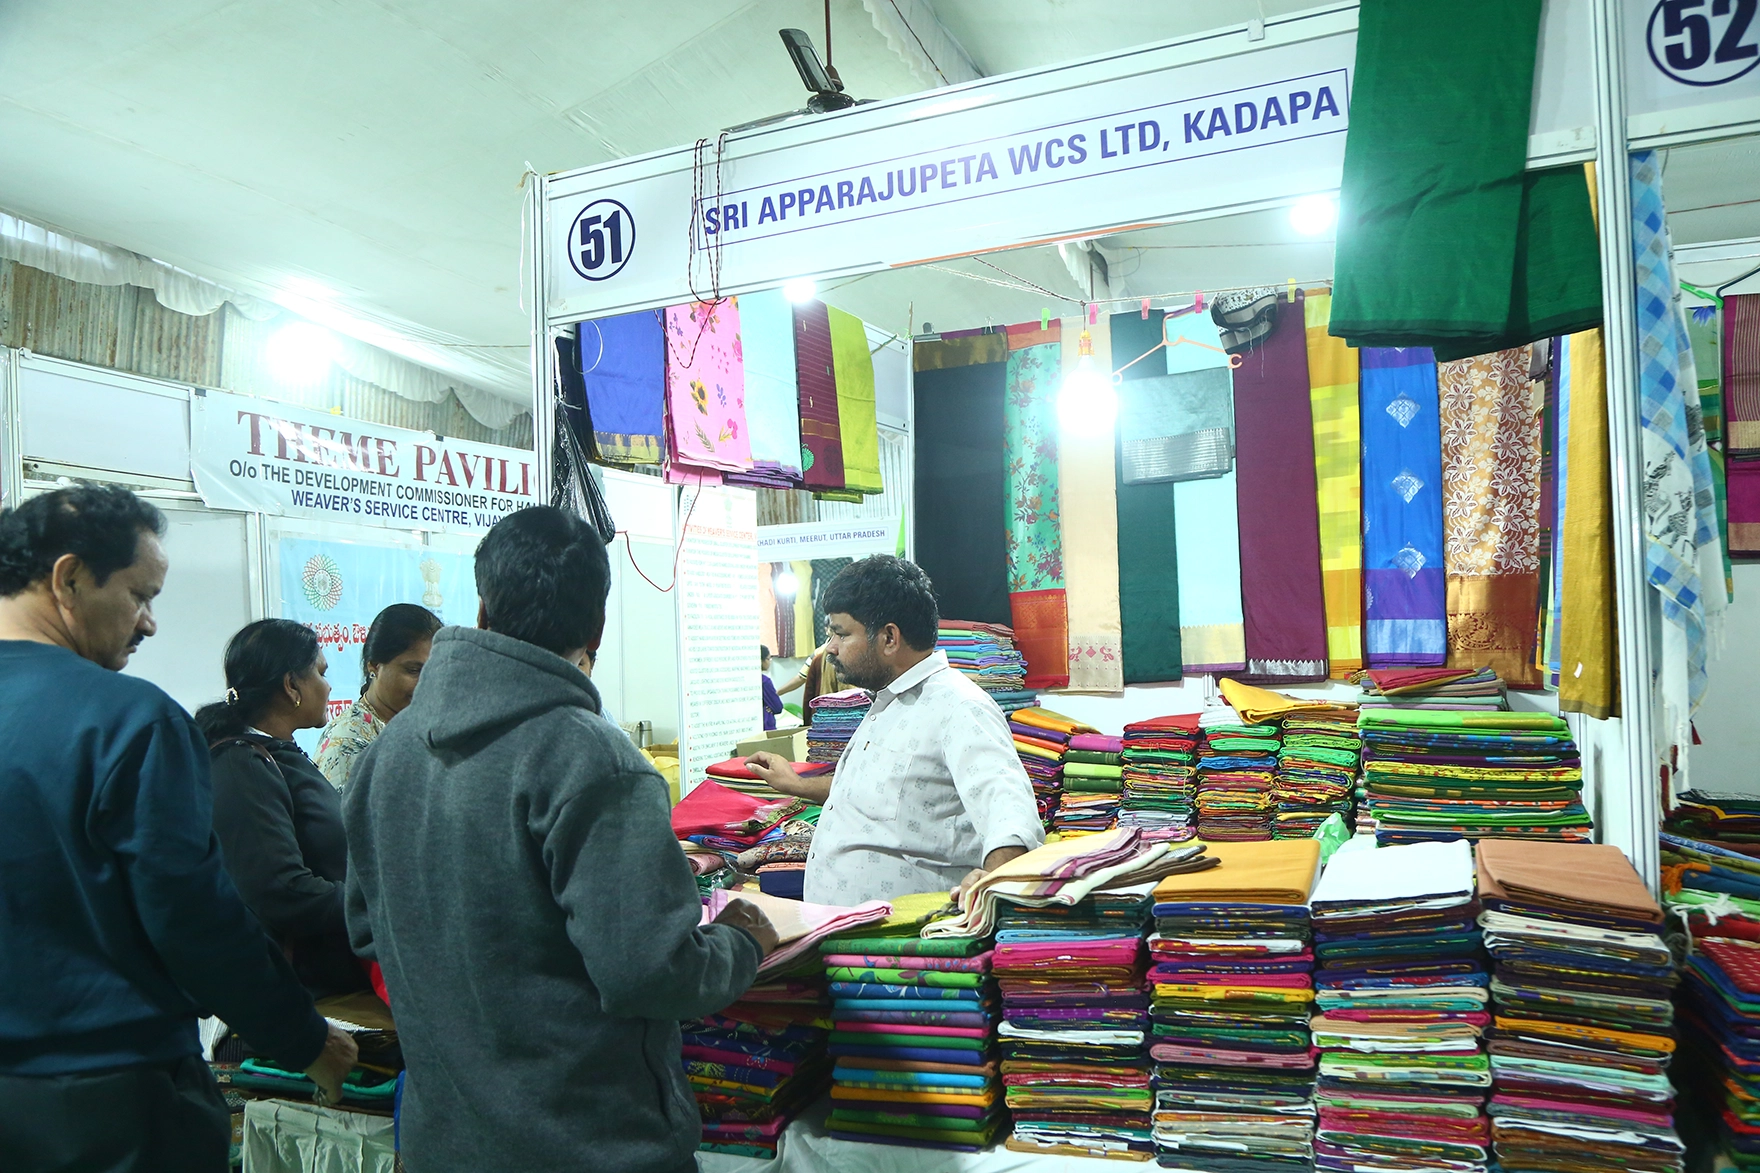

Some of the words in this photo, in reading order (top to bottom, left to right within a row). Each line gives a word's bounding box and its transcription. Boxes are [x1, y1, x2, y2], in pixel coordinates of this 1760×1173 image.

[1663, 0, 1758, 70] 52
[705, 201, 748, 236] SRI
[758, 152, 998, 225] APPARAJUPETA
[1008, 133, 1087, 175] WCS
[1100, 120, 1170, 159] LTD,
[1183, 86, 1340, 144] KADAPA
[580, 210, 623, 270] 51
[238, 410, 400, 478] THEME
[413, 444, 535, 496] PAVILI
[229, 459, 257, 479] O/o
[261, 463, 290, 484] THE
[295, 468, 393, 498] DEVELOPMENT
[396, 485, 487, 510] COMMISSIONER
[491, 499, 514, 513] FOR
[291, 489, 362, 513] WEAVER'S
[365, 499, 418, 520] SERVICE
[422, 506, 472, 528] CENTRE,
[830, 532, 851, 541] UTTAR
[853, 529, 885, 539] PRADESH
